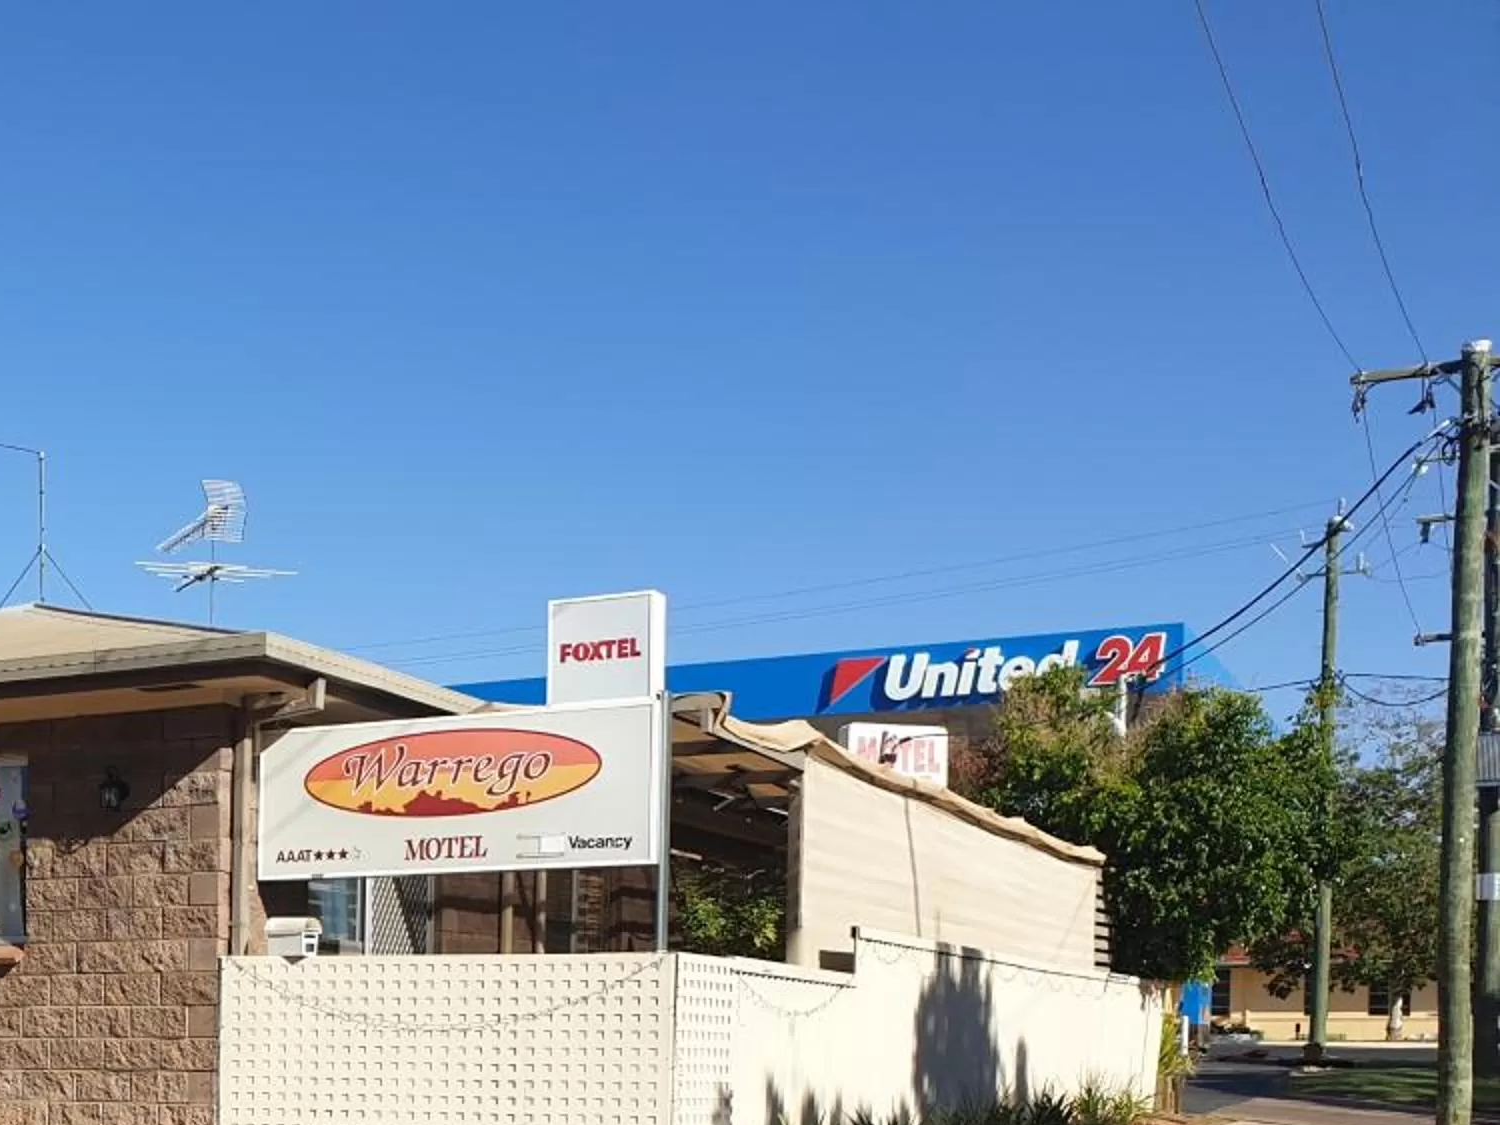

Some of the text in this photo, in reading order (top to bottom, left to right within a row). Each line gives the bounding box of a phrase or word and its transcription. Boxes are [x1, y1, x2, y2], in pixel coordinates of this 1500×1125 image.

[559, 637, 642, 664] FOXTEL
[884, 631, 1167, 701] United 24
[856, 735, 941, 773] MTEL
[343, 744, 552, 797] Warrego
[403, 835, 488, 861] MOTEL
[567, 834, 633, 851] Vacancy
